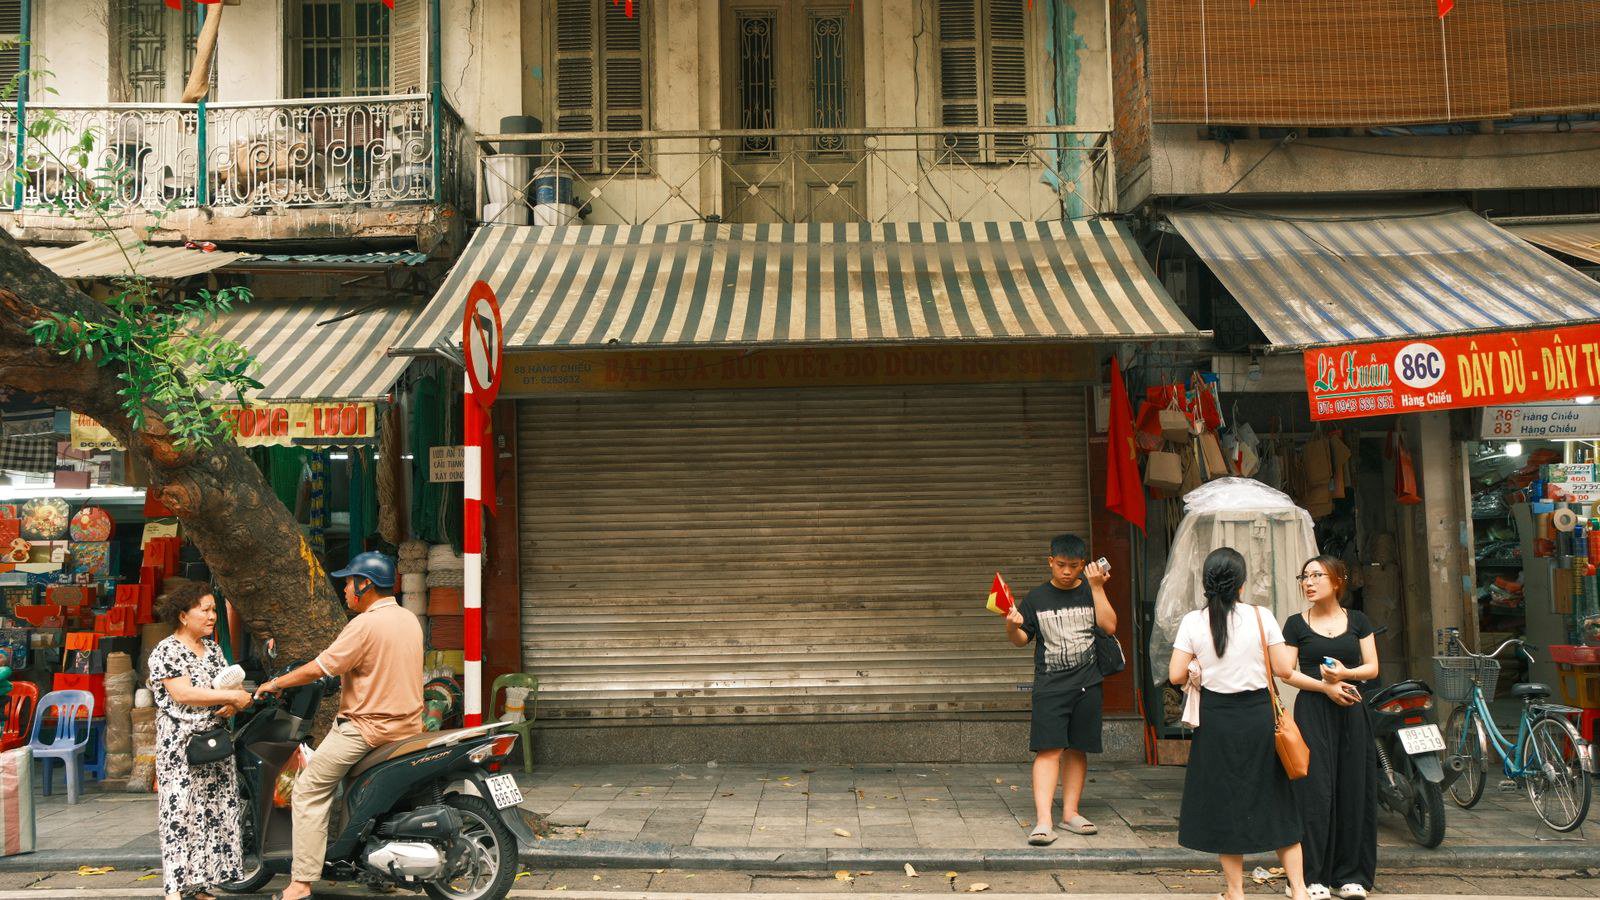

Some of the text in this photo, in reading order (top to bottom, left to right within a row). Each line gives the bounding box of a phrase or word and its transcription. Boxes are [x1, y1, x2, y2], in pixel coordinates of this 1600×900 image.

[1016, 348, 1074, 375] SINH
[1401, 352, 1440, 381] 86C
[1457, 340, 1495, 398] DÂY
[1499, 337, 1527, 394] DÙ
[1541, 334, 1578, 391] DÂY
[1401, 390, 1453, 407] Hàng Chiếu
[1494, 422, 1576, 437] 83 Hàng Chiếu
